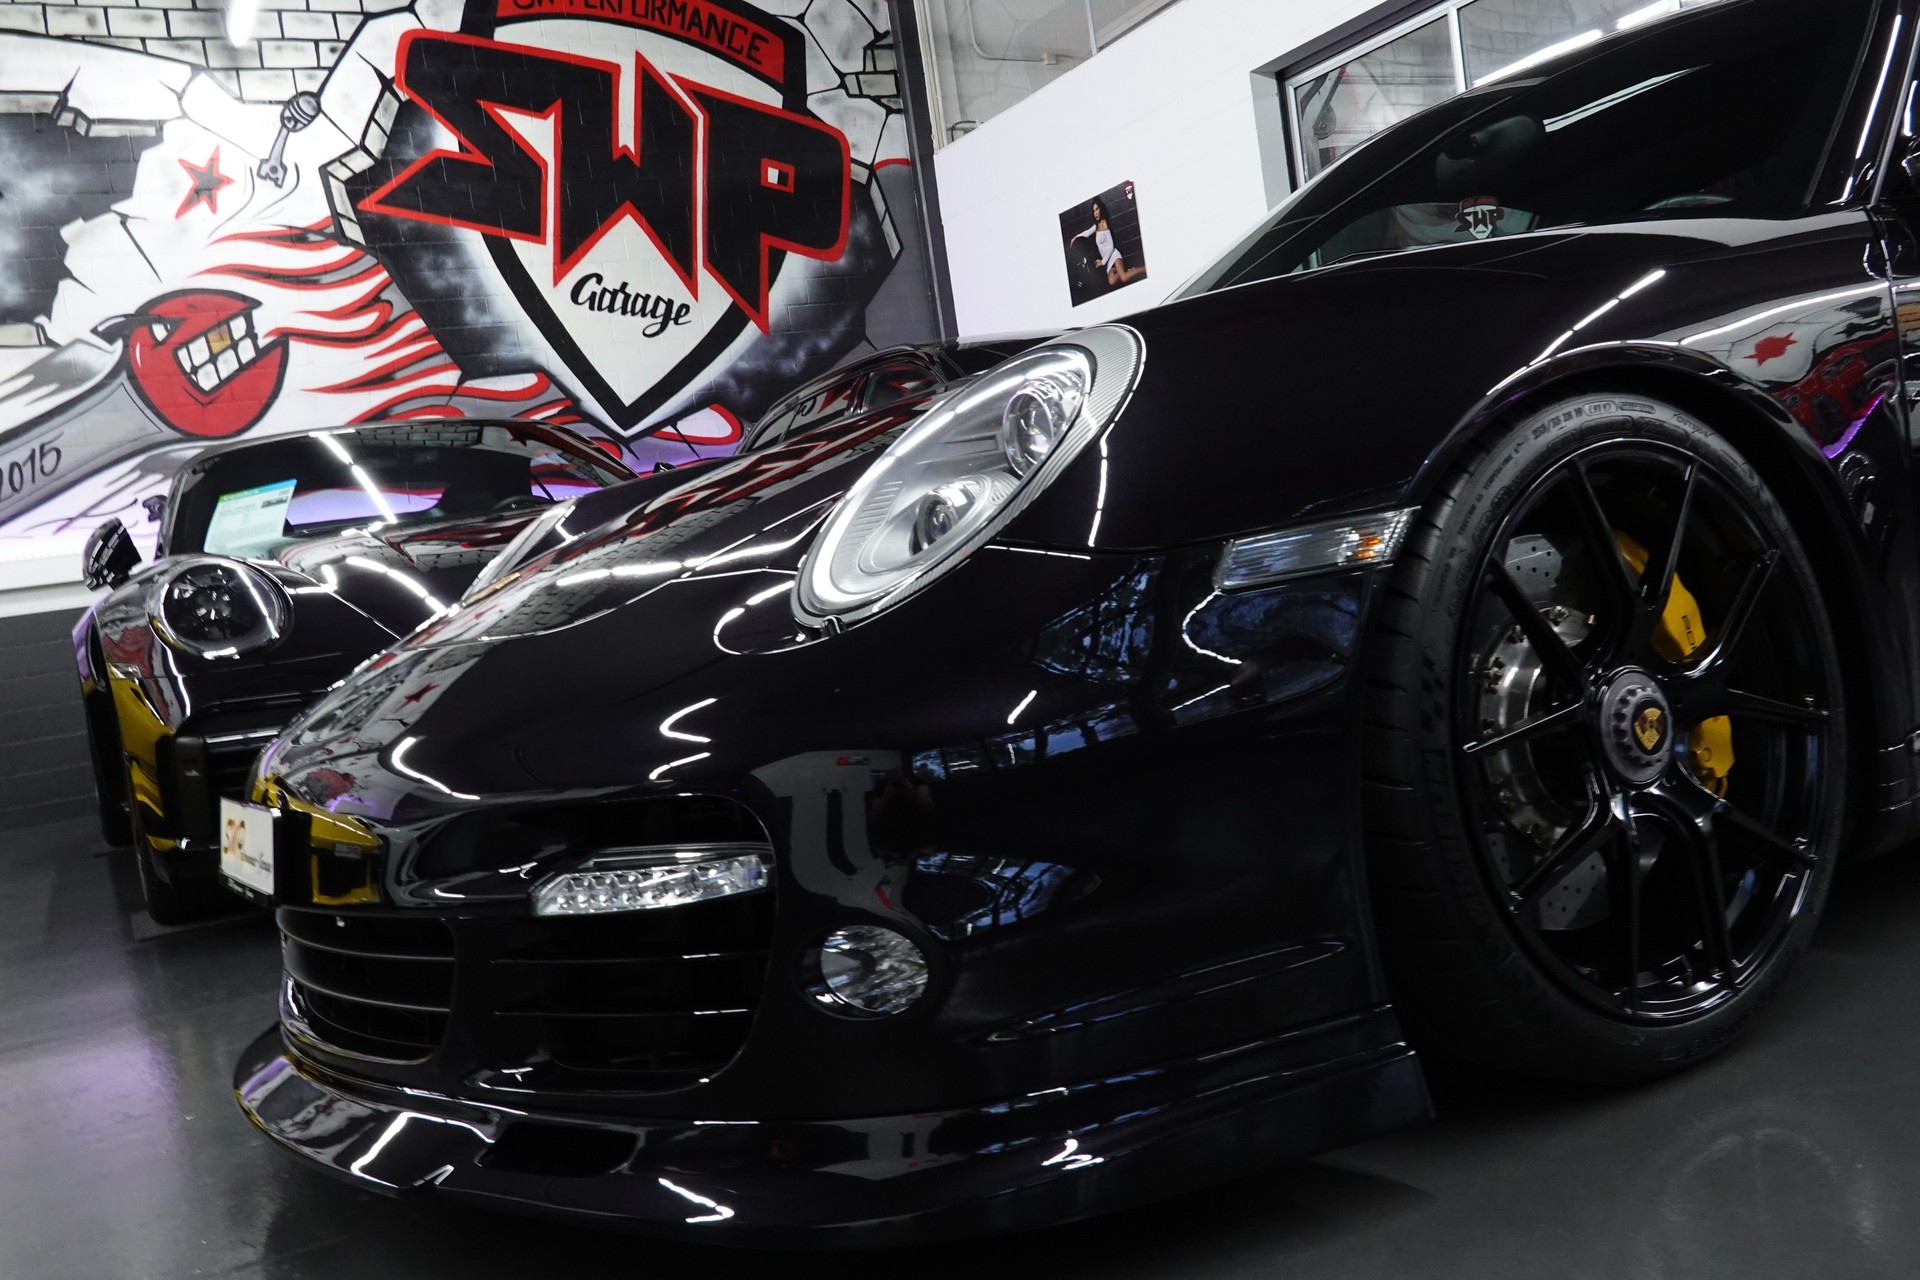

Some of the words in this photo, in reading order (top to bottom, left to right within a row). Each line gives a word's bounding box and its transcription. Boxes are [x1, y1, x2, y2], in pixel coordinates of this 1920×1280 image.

[357, 28, 851, 335] SWP
[570, 272, 692, 338] Garage
[0, 431, 64, 500] 015
